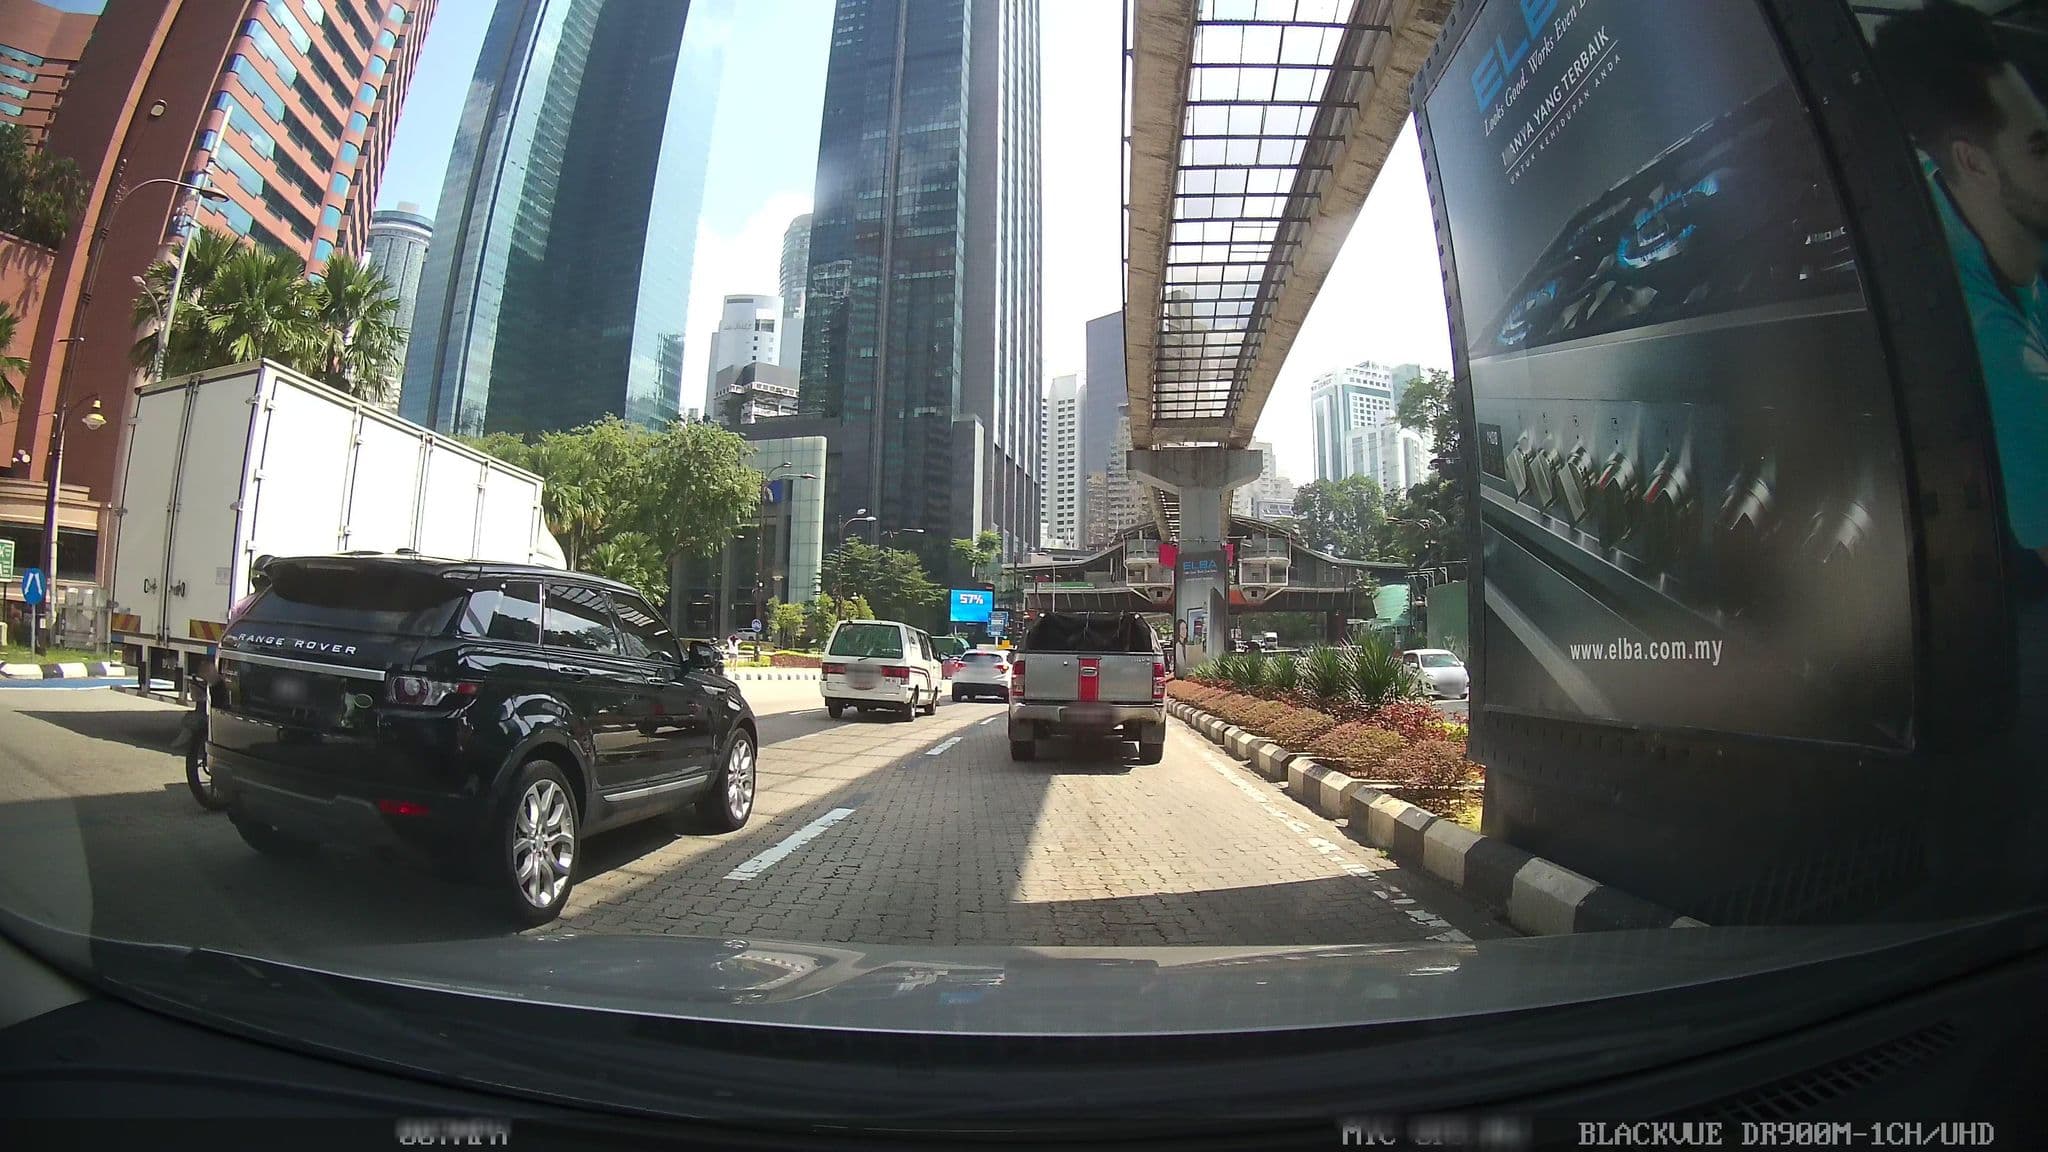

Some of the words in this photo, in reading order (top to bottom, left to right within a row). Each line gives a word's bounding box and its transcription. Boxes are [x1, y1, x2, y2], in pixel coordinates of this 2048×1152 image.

[1472, 0, 1559, 113] ELB
[1505, 68, 1529, 108] Good.
[1527, 36, 1554, 74] Works
[1554, 6, 1578, 41] Even
[1532, 86, 1562, 125] YANG
[1561, 25, 1609, 91] TERBAIK
[1510, 154, 1536, 185] UNTUK
[1539, 89, 1590, 151] KEHIDUPAN
[1595, 54, 1621, 88] ANDA
[1183, 560, 1217, 570] ELBA
[960, 594, 984, 605] 57%
[238, 633, 285, 646] RANGE
[294, 639, 357, 655] ROVER
[1570, 637, 1723, 666] www.elba.com.my
